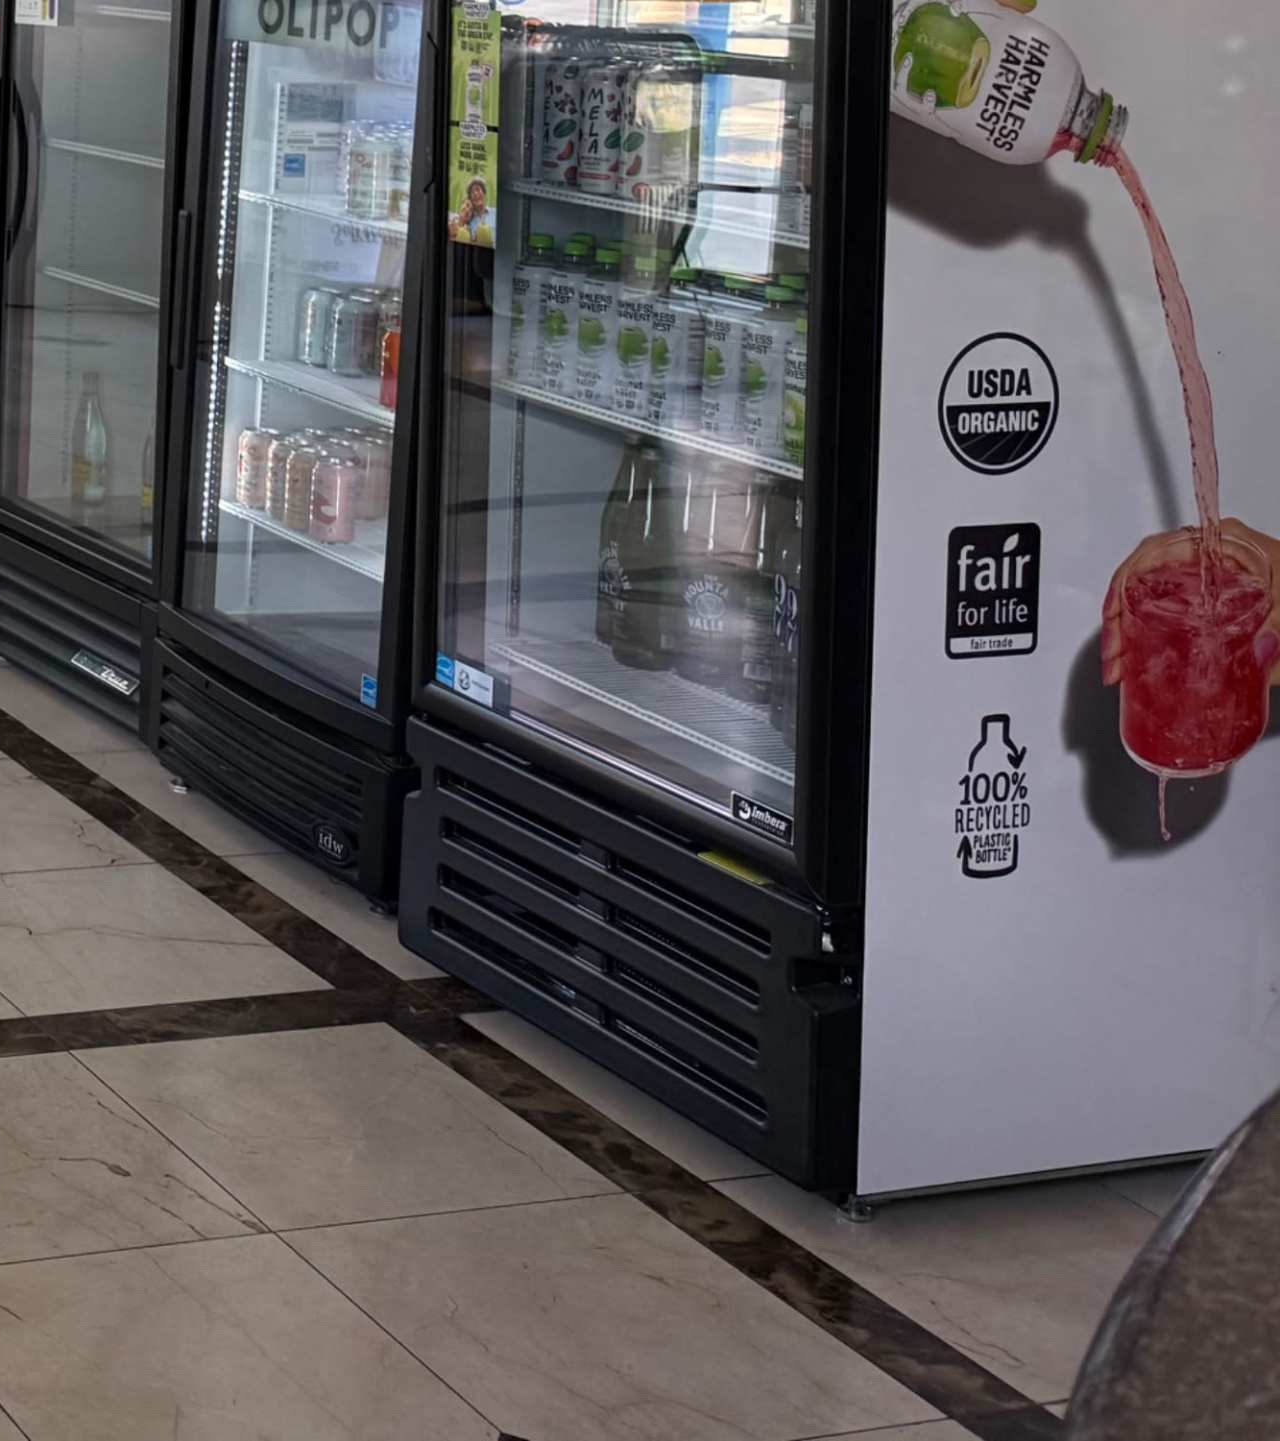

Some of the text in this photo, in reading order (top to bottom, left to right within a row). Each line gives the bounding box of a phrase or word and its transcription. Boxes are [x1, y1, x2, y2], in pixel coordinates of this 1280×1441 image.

[976, 34, 1027, 137] HARVEST
[994, 37, 1050, 152] HARMLESS
[588, 88, 604, 154] MELA
[968, 368, 1032, 398] USDA
[958, 409, 1039, 435] ORGANIC
[957, 540, 1031, 592] fair
[684, 581, 729, 603] MOUNTA
[688, 615, 725, 632] VALLE
[957, 598, 1028, 627] for life
[970, 637, 1014, 650] fair trade
[958, 771, 1029, 805] 100%
[752, 806, 787, 831] imbera
[955, 803, 1031, 833] RECYCLED
[973, 833, 1011, 849] PLASTIC
